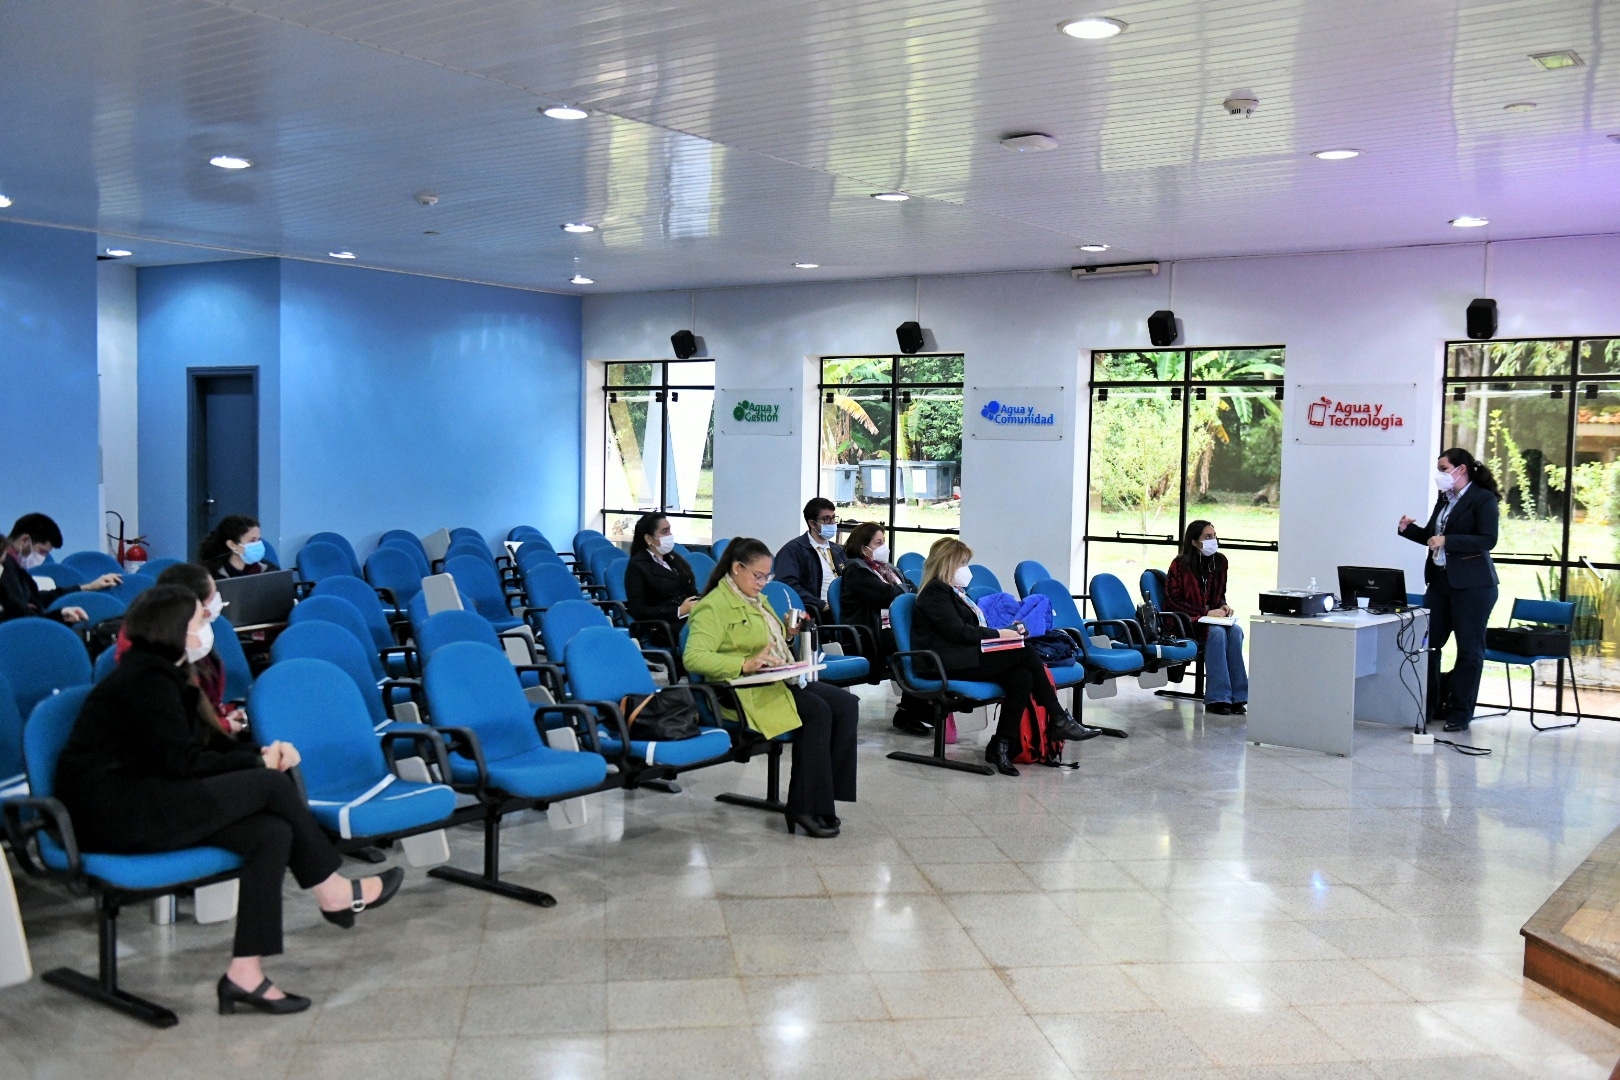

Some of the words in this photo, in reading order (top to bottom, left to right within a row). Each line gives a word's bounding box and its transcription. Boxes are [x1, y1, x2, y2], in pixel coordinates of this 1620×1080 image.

[748, 403, 772, 414] Agua
[1000, 405, 1026, 416] Agua
[1028, 406, 1034, 416] y
[1335, 402, 1370, 416] Agua
[1374, 404, 1382, 416] y
[995, 414, 1054, 424] Comunidad
[1329, 414, 1403, 430] Tecnología
